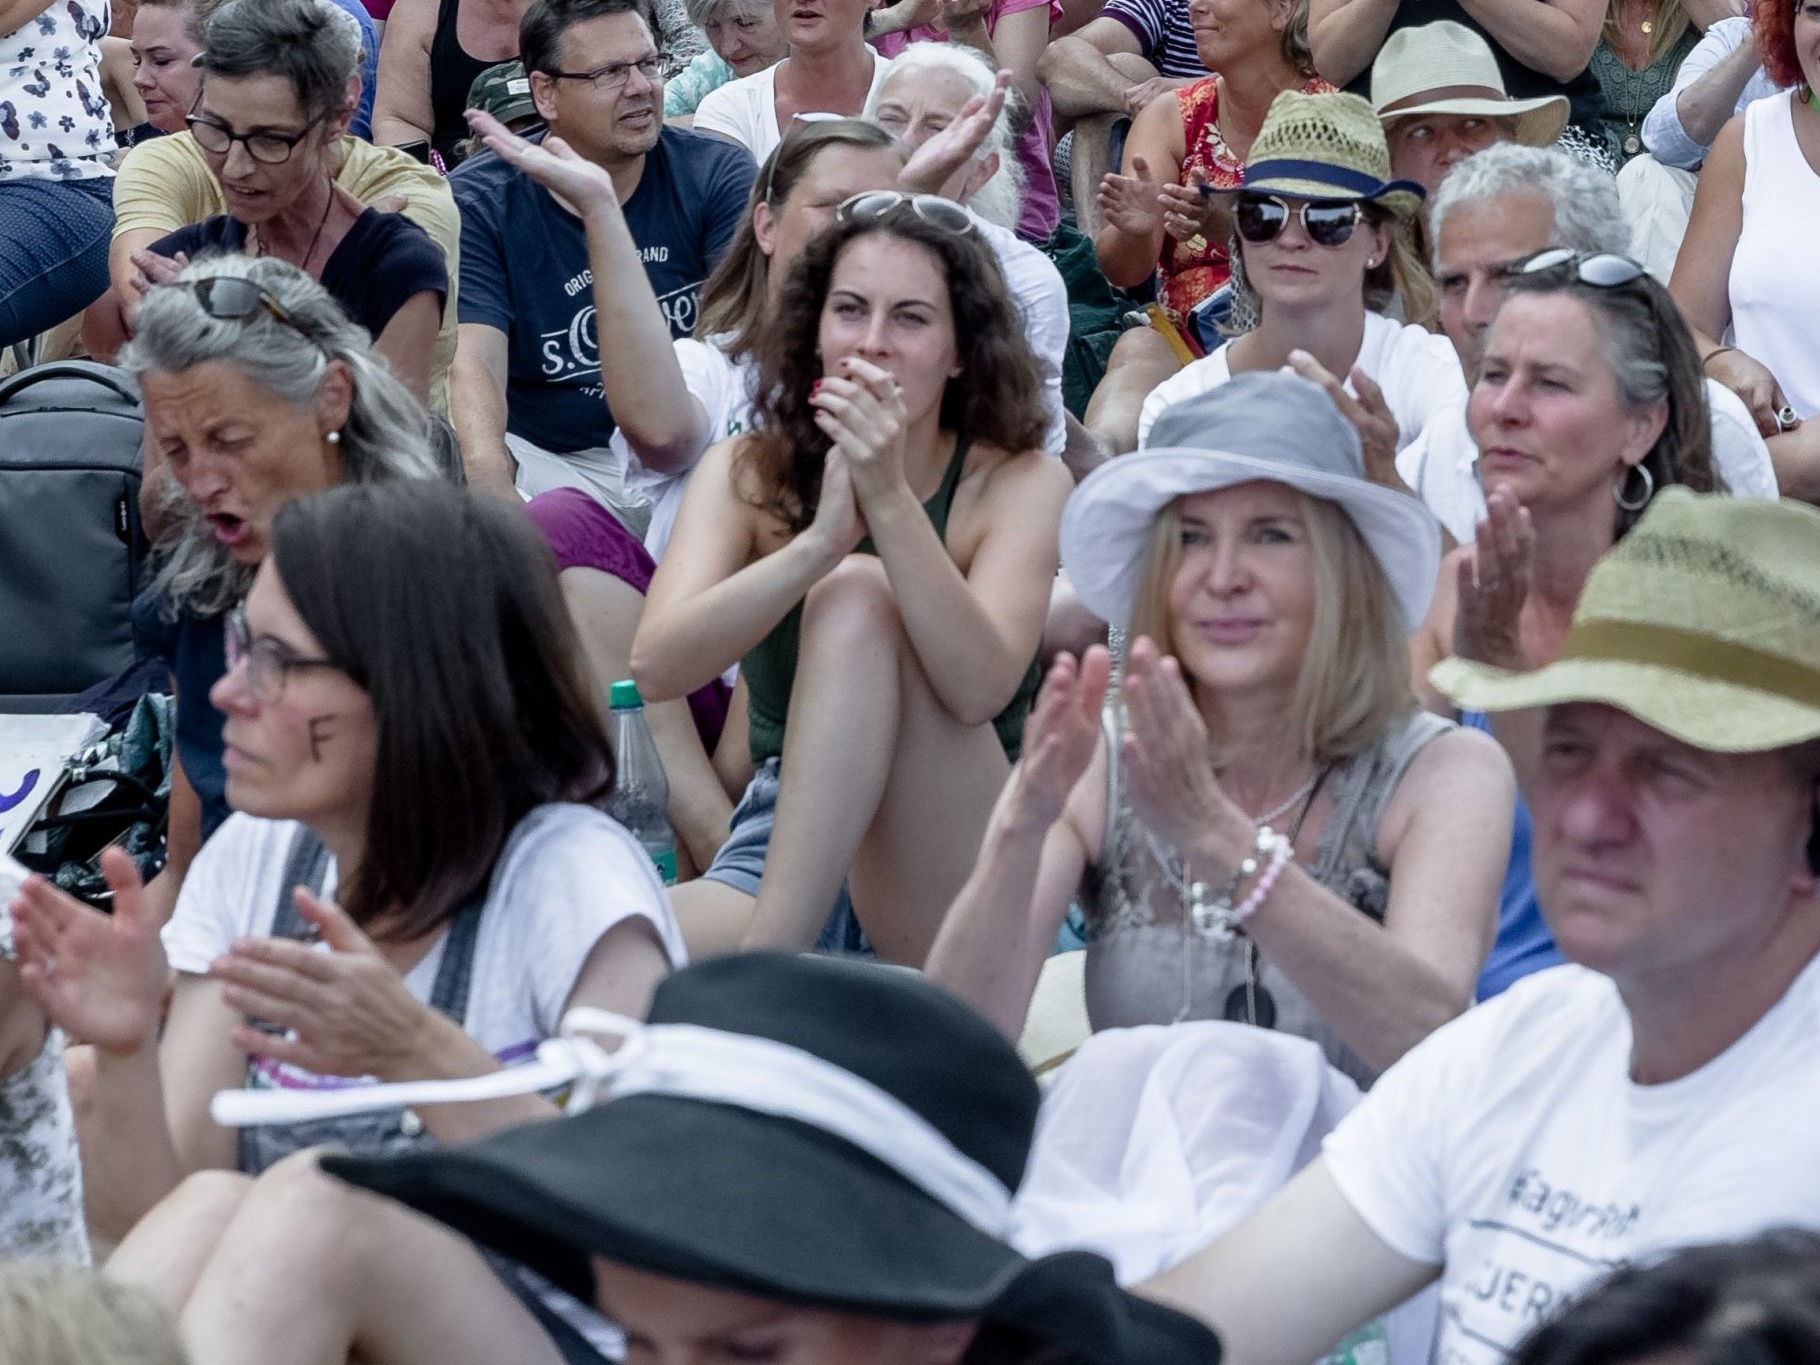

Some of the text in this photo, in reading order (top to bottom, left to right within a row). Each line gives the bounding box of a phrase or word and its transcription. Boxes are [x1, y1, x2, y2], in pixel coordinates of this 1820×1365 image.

[564, 246, 668, 297] ORIG RAND
[542, 292, 704, 374] s.Over
